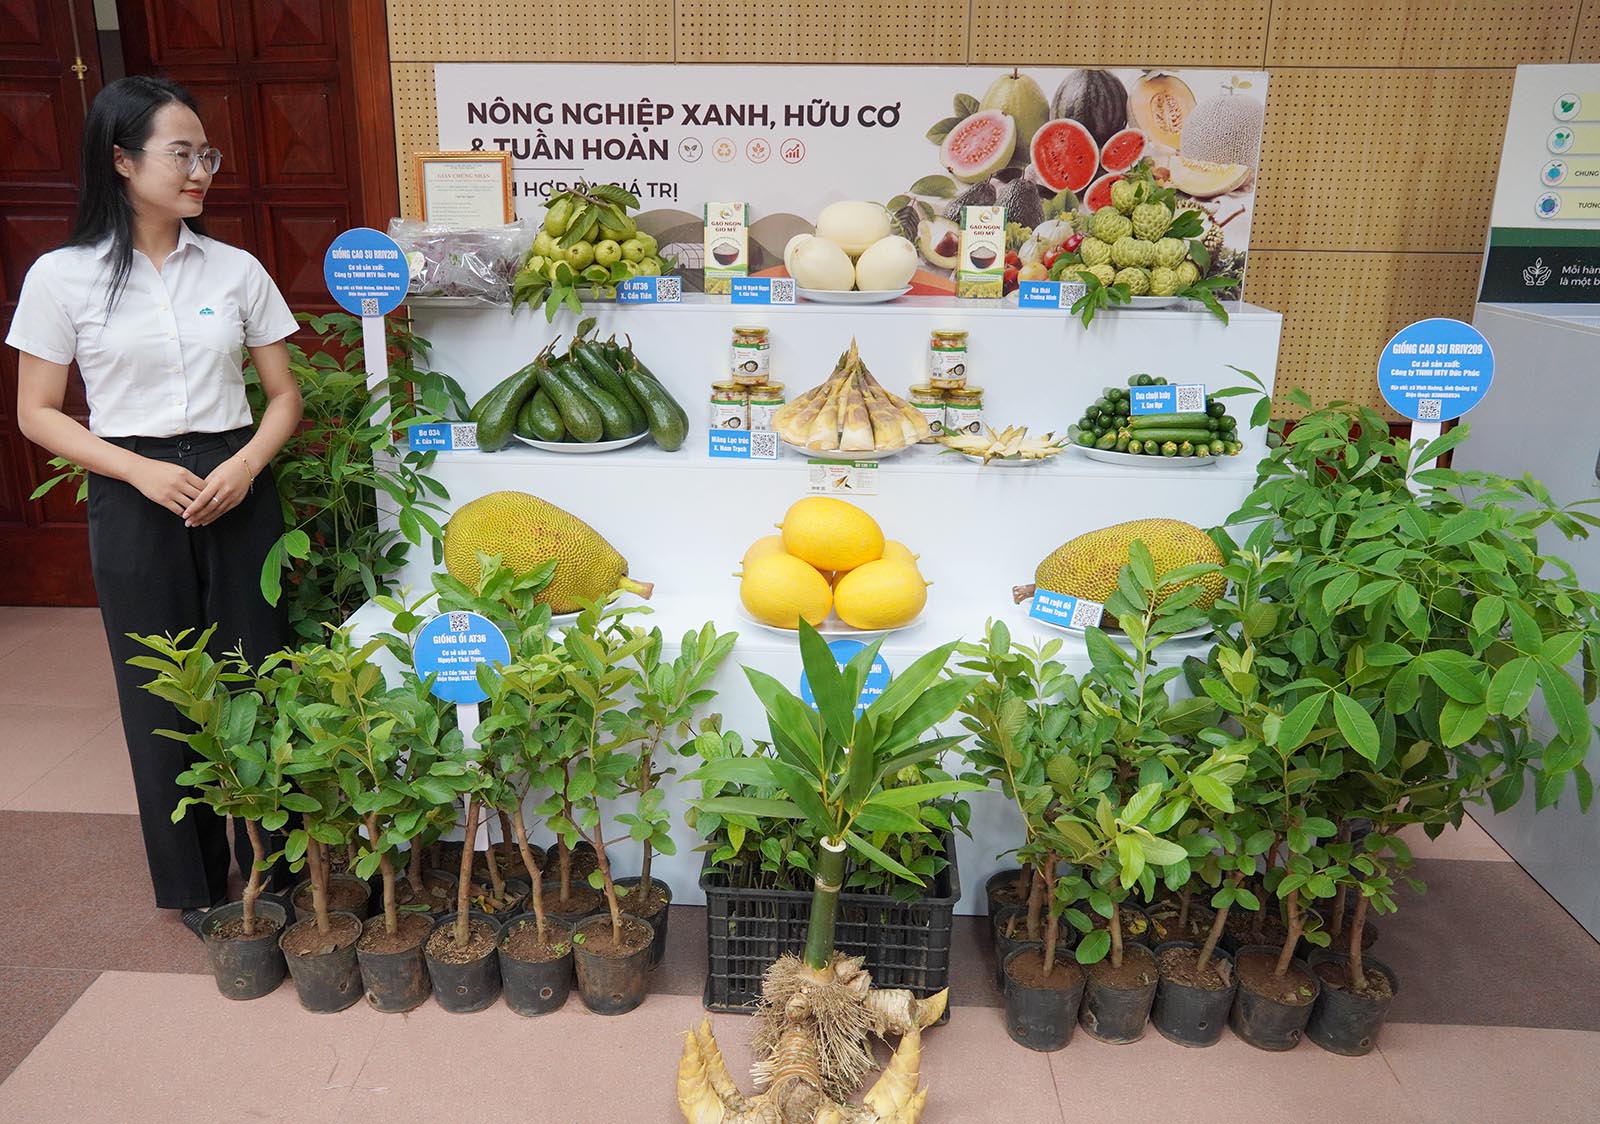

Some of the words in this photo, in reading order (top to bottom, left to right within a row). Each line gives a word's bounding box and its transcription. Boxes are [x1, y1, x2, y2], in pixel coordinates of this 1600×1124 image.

[467, 96, 554, 125] NÔNG
[561, 97, 674, 133] NGHIỆP
[681, 103, 776, 130] XANH,
[784, 98, 850, 128] HỮU
[857, 101, 901, 128] CƠ
[493, 128, 574, 161] TUẦN
[582, 133, 669, 161] HOÀN
[647, 182, 678, 202] TRỊ
[1562, 264, 1579, 274] Mỗi
[1560, 275, 1569, 285] là
[1393, 340, 1417, 354] GIỐNG
[1419, 344, 1435, 354] CAO
[1436, 344, 1447, 354] SU
[433, 633, 457, 645] GIỐNG
[468, 634, 487, 643] AT36
